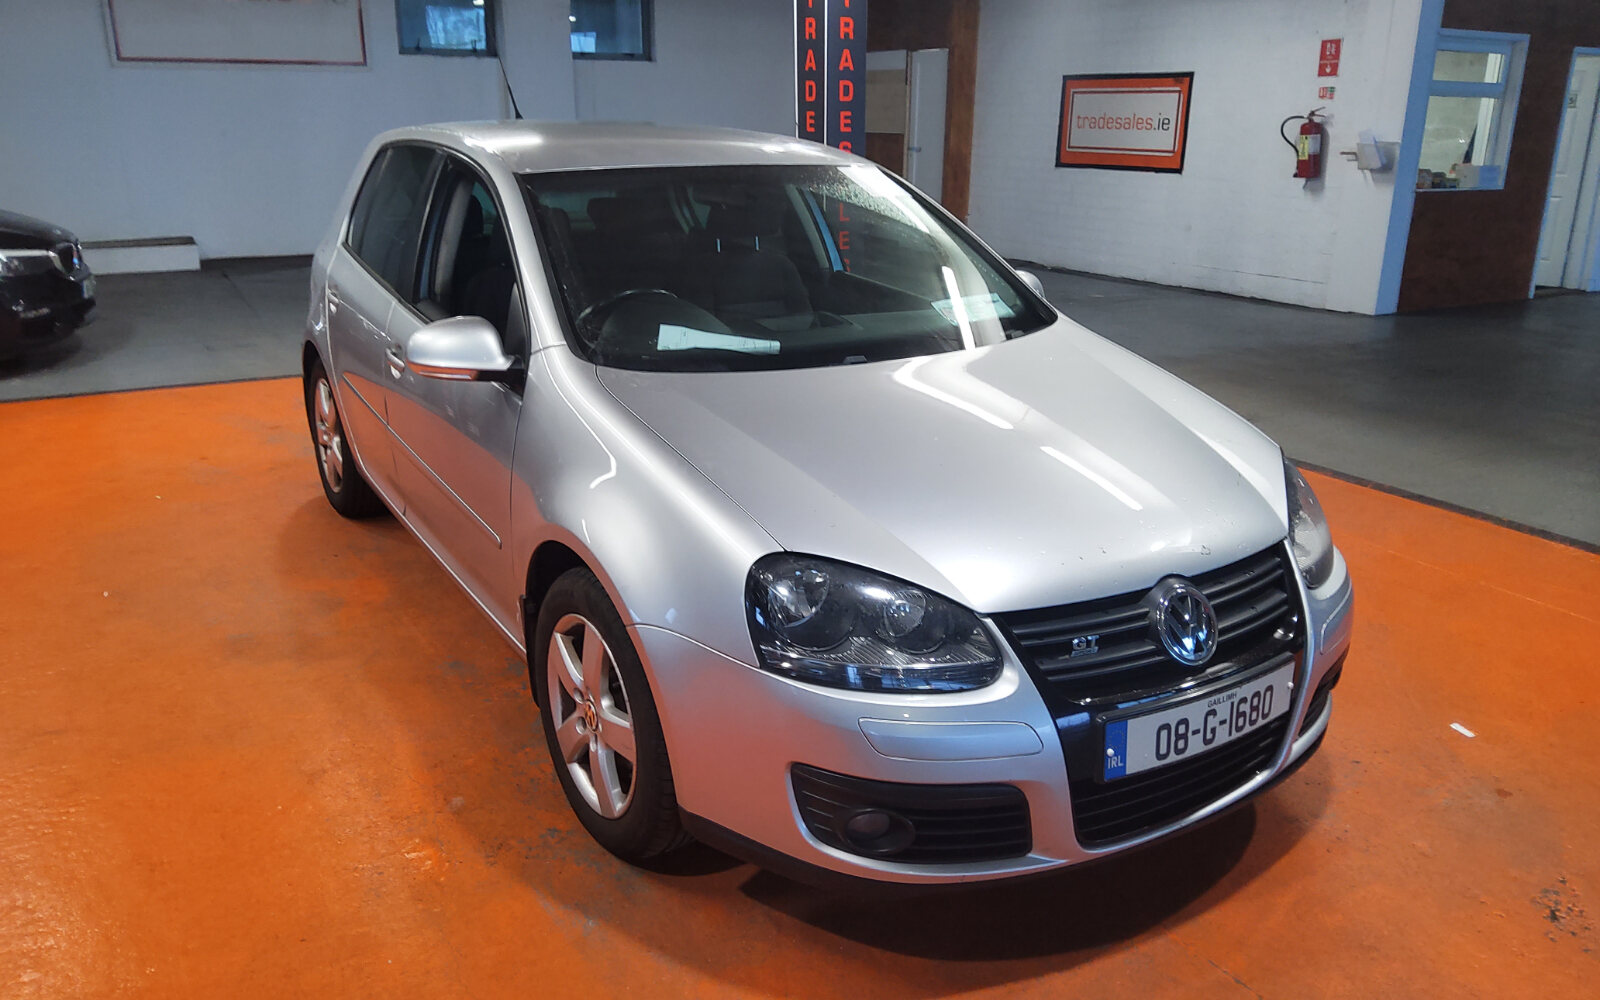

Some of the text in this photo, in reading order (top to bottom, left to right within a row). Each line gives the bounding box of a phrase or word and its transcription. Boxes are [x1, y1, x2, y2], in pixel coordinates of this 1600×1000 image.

[1077, 112, 1171, 131] tradesales.ie
[1072, 635, 1100, 650] GT
[1207, 691, 1238, 708] GAILLIMH
[1155, 684, 1275, 761] 08-G-1680
[1107, 755, 1125, 769] IRL
